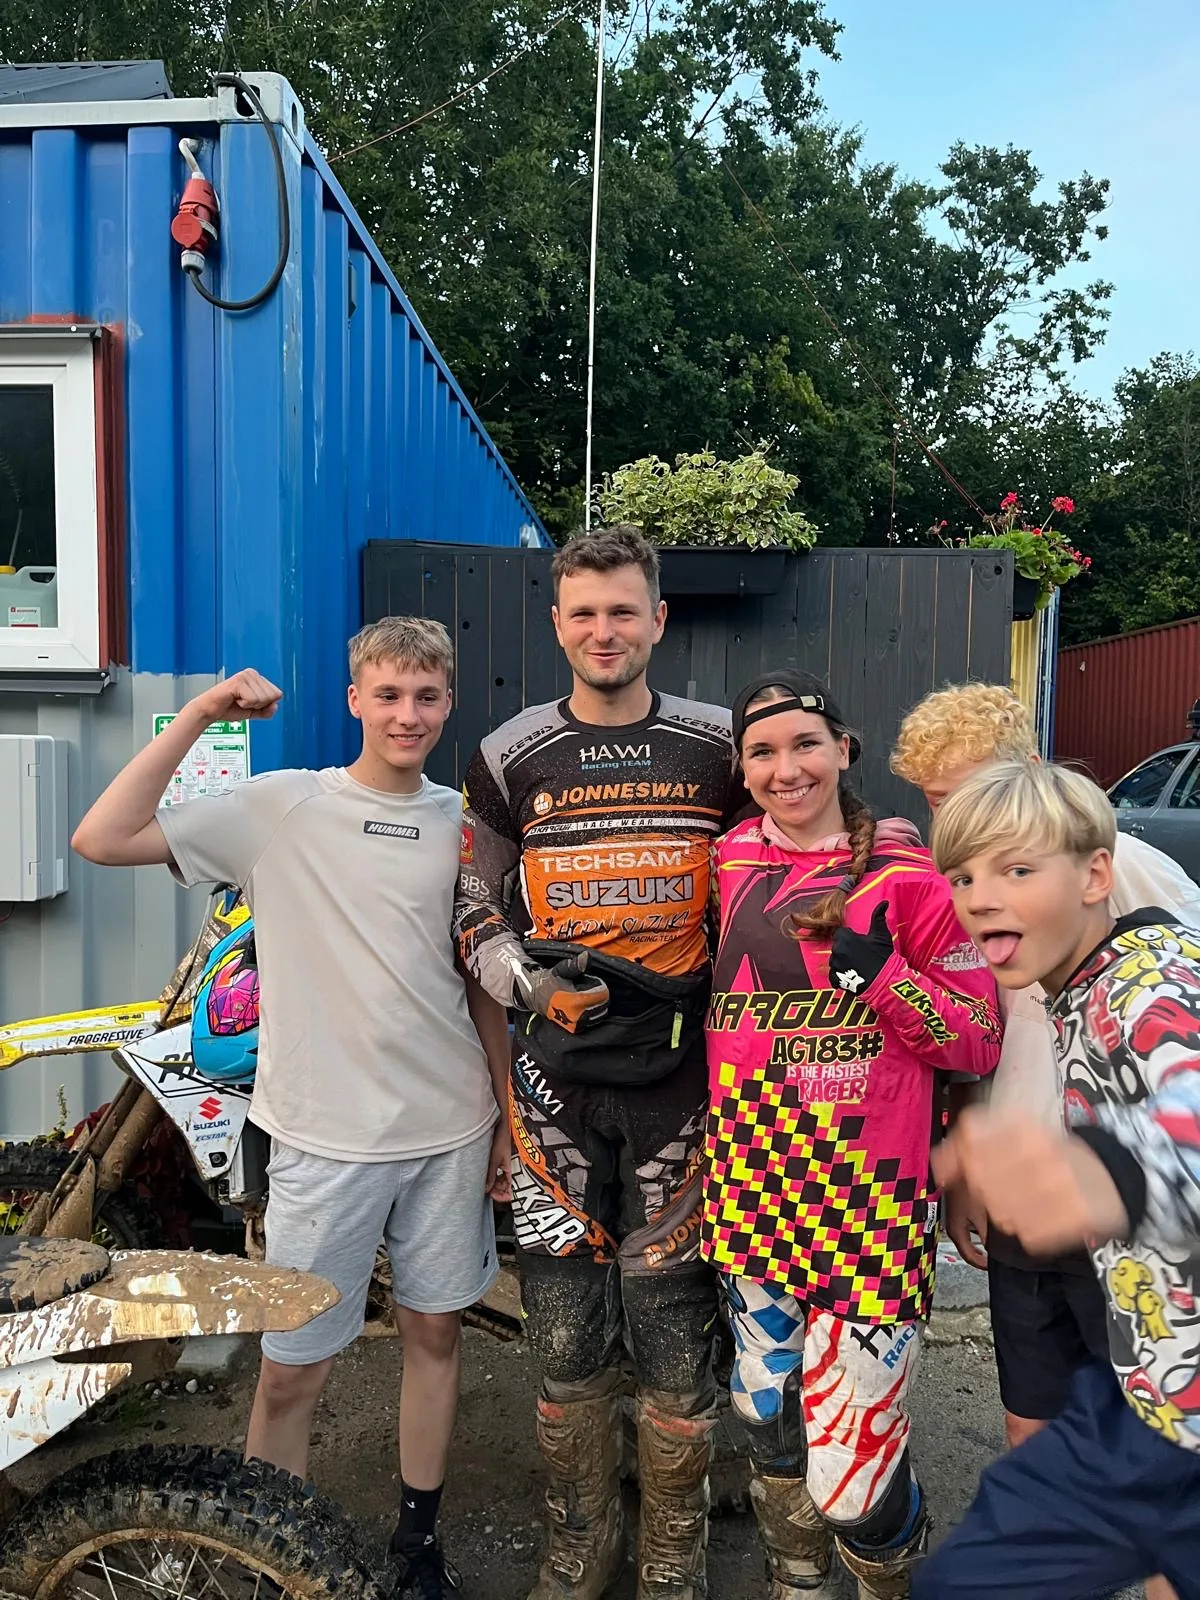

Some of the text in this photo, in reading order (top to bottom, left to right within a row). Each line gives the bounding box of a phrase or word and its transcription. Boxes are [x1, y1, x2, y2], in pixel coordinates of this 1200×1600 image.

[667, 714, 732, 738] ACERBIS
[500, 725, 553, 765] ACERBIS
[579, 743, 651, 763] HAWI
[581, 759, 652, 770] Racing TEAM
[556, 781, 700, 807] JONNESWAY
[366, 823, 418, 838] HUMMEL
[582, 820, 613, 829] RACE
[621, 818, 654, 827] WEAR
[539, 850, 681, 874] TECHSAM
[460, 873, 490, 896] BBS
[545, 873, 694, 909] SUZUKI
[629, 934, 658, 944] RACING
[67, 1028, 145, 1046] PROGRESSIVE
[770, 1030, 884, 1065] AG183#
[786, 1061, 871, 1079] IS THE FASTEST
[517, 1051, 565, 1116] HAWI
[798, 1076, 868, 1104] RACER
[193, 1119, 231, 1131] SUZUKI
